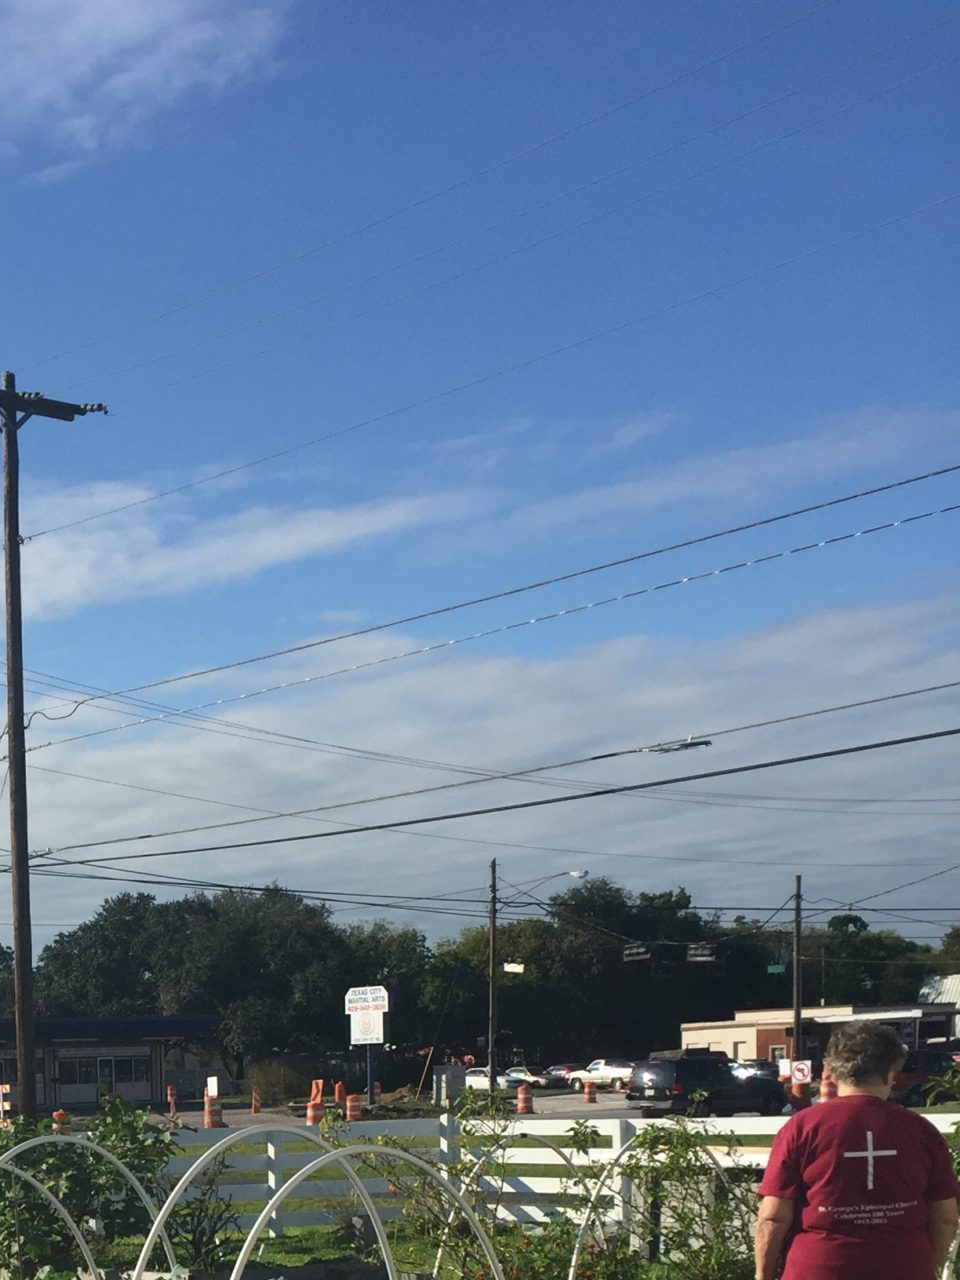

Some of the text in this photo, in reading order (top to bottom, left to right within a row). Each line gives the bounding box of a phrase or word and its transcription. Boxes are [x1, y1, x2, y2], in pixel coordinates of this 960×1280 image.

[828, 1204, 860, 1213] George's
[861, 1203, 895, 1212] Episcopal
[895, 1200, 918, 1209] Church
